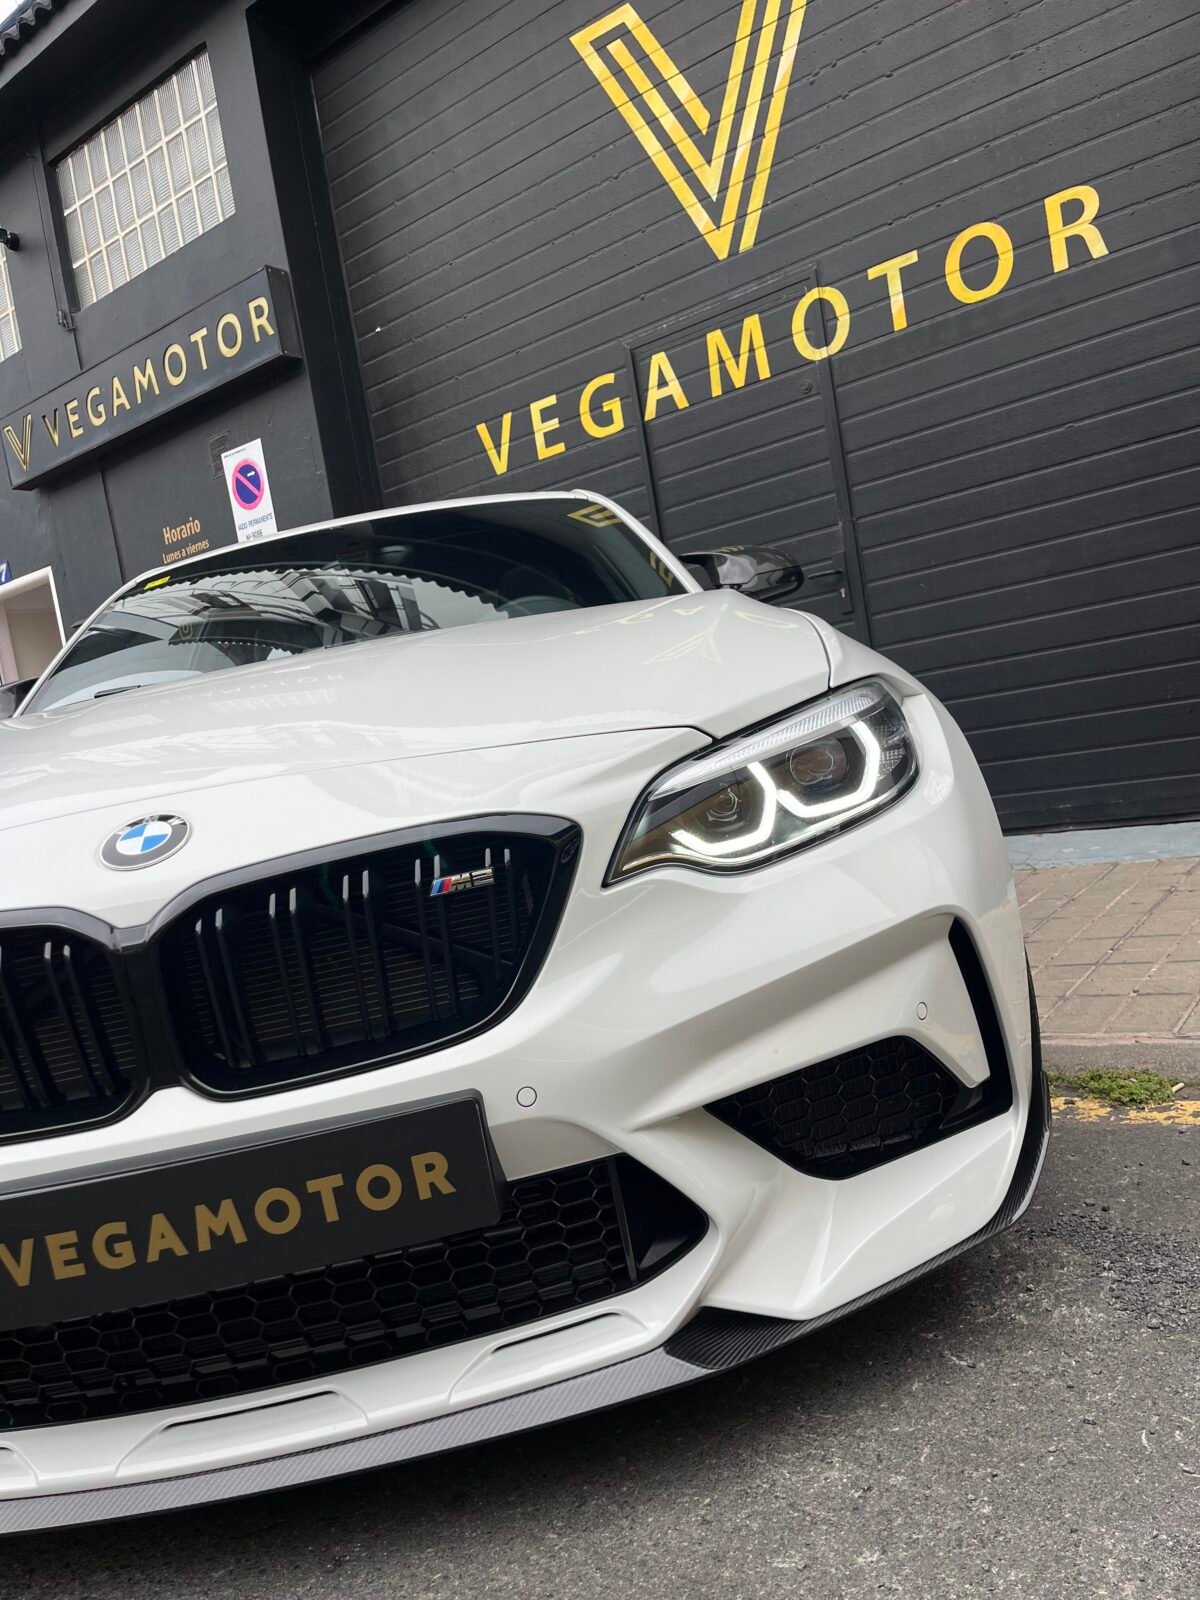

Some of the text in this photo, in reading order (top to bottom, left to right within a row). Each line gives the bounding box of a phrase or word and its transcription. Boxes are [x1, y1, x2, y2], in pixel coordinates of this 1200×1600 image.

[42, 296, 276, 448] VEGAMOTOR
[476, 184, 1109, 476] VEGAMOTOR
[163, 517, 201, 545] Horario
[163, 550, 182, 564] Lunes
[186, 539, 209, 555] viernes
[0, 1151, 457, 1288] VEGAMOTOR
